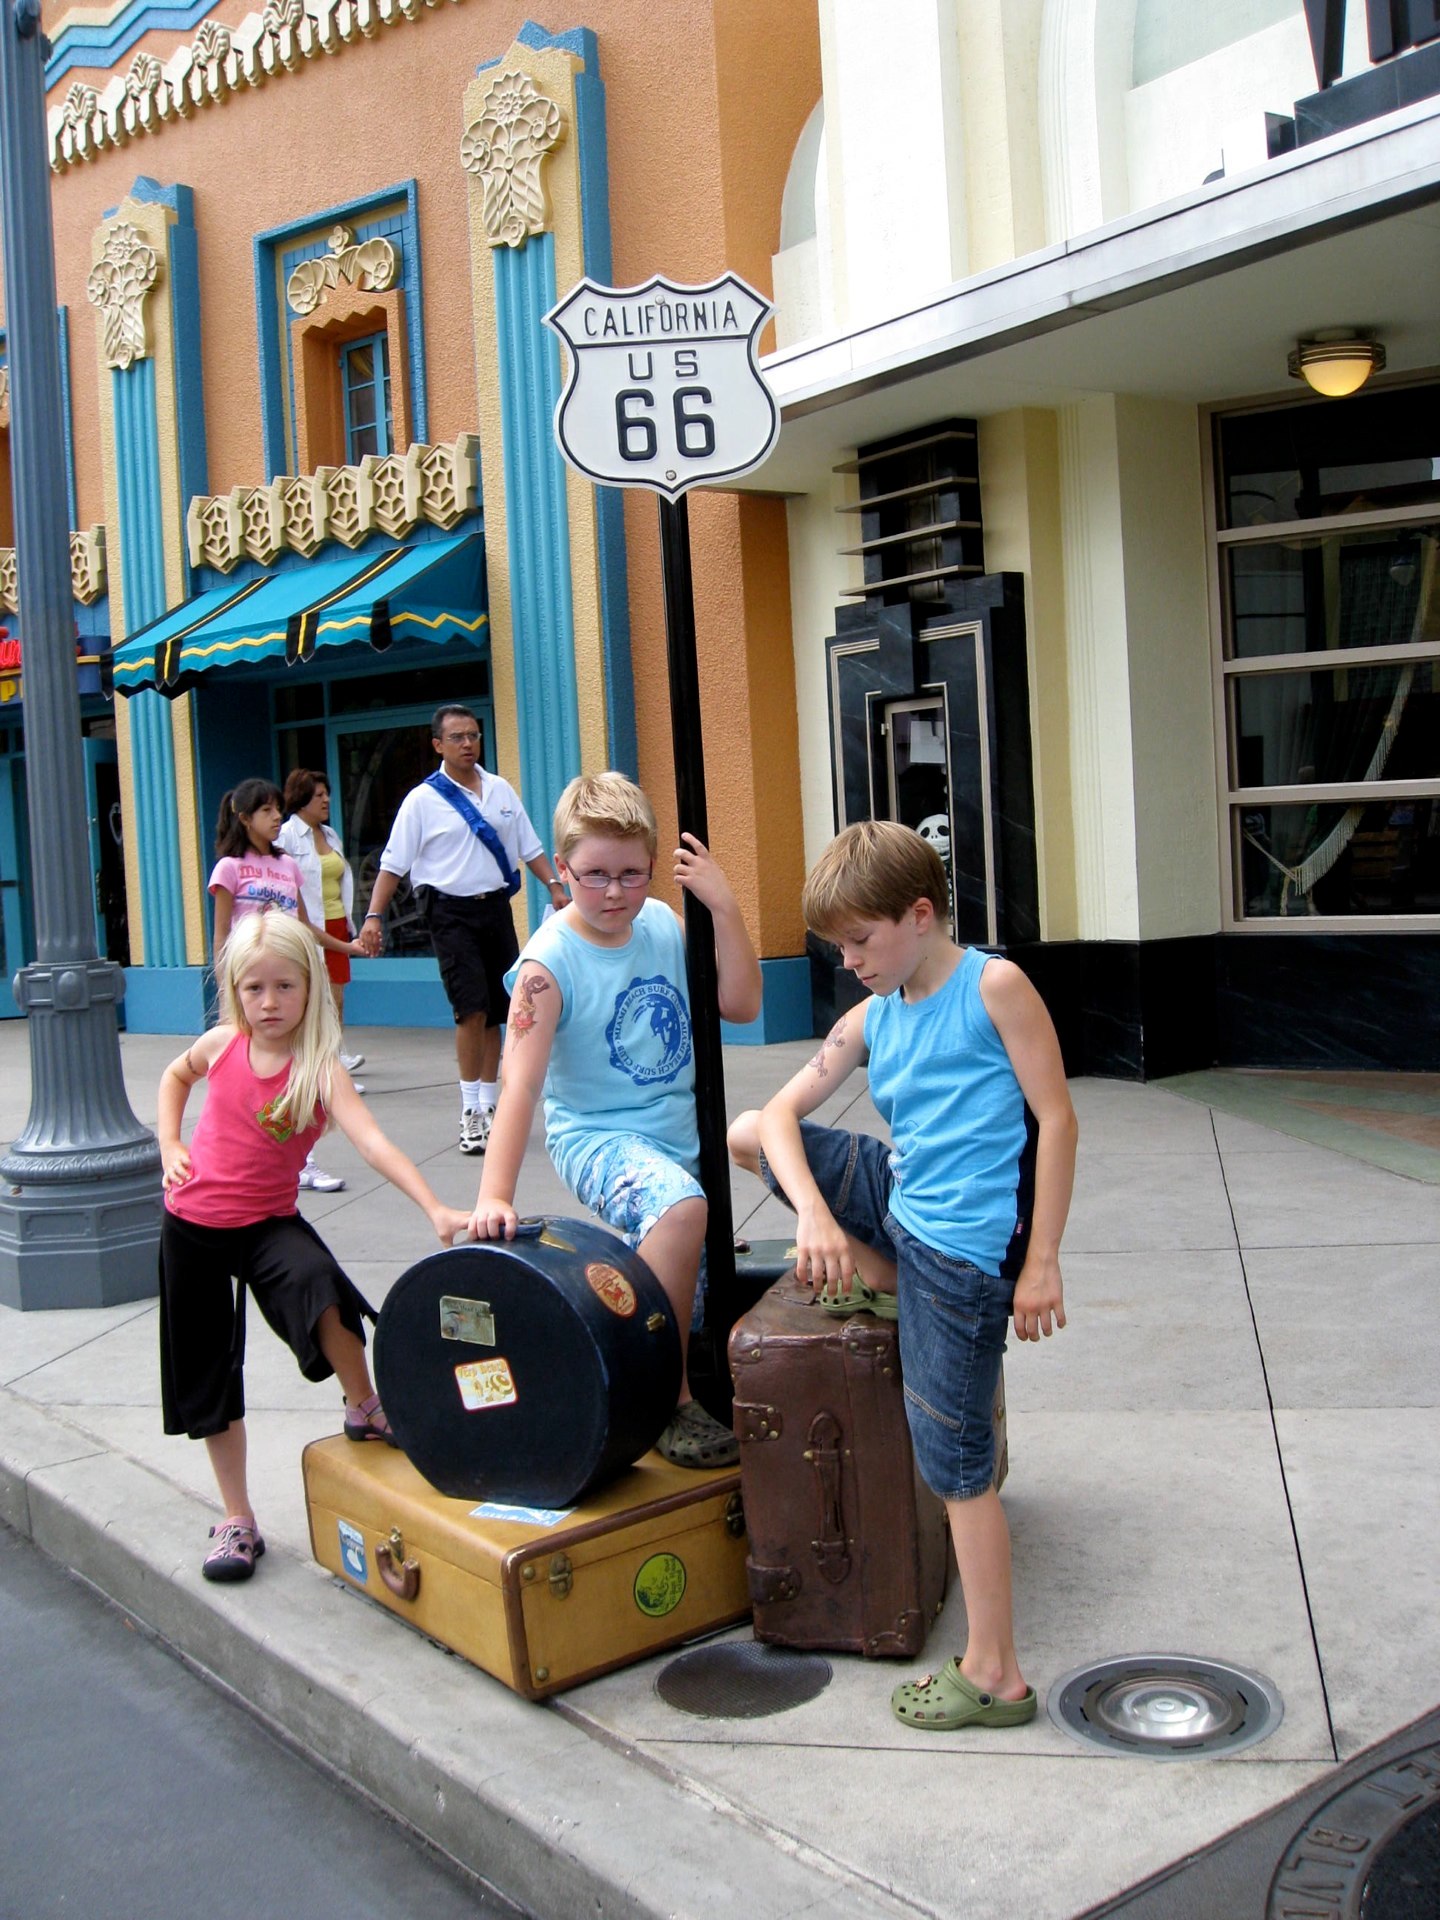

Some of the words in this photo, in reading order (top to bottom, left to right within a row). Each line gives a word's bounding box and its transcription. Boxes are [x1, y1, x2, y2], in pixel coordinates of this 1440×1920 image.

[584, 300, 738, 337] CALIFORNIA
[615, 386, 716, 462] 66
[240, 865, 262, 879] My
[614, 1008, 628, 1041] MIAMI
[625, 987, 646, 1009] BEACH
[647, 985, 670, 995] SURF
[616, 1045, 633, 1067] CLUB
[633, 1063, 657, 1076] SURF
